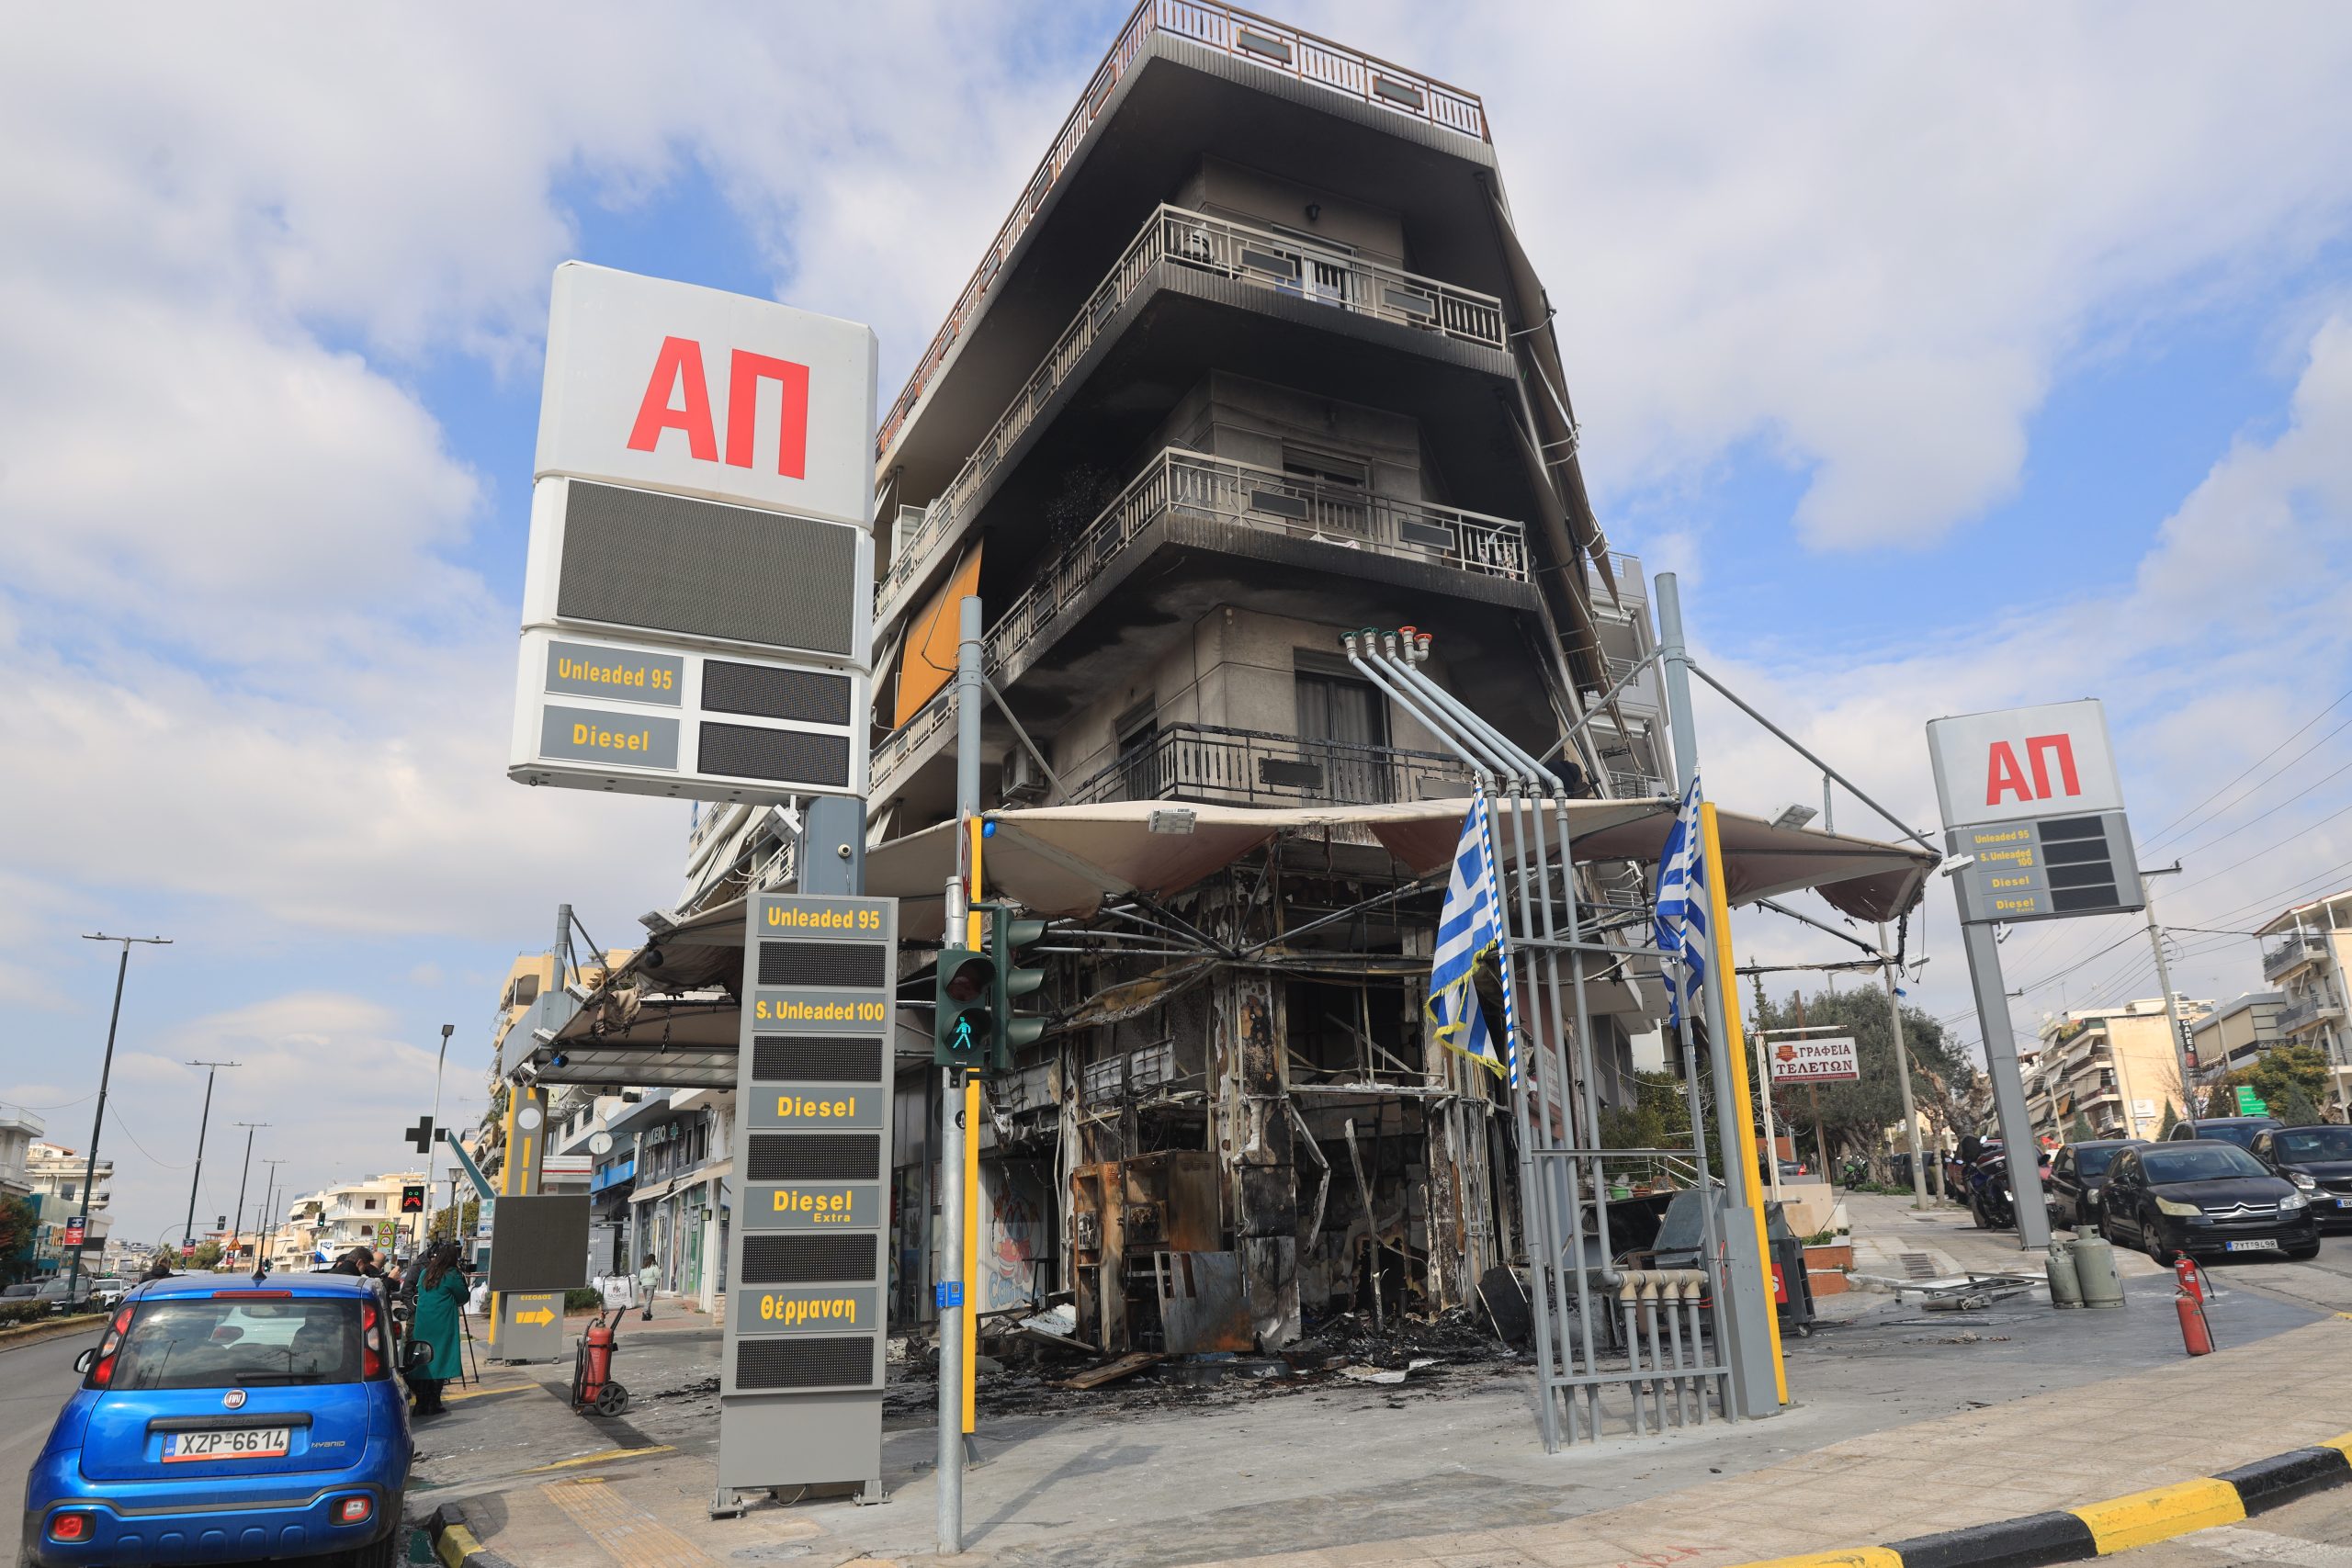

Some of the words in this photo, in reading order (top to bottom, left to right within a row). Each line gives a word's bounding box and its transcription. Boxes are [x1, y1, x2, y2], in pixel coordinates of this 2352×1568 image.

[559, 659, 645, 687] Unleaded
[651, 668, 673, 690] 95
[573, 724, 650, 751] Diesel
[1974, 831, 2017, 843] Unleaded
[2018, 829, 2030, 839] 95
[1980, 852, 1989, 862] S.
[1990, 848, 2031, 861] Unleaded
[2018, 857, 2033, 866] 100
[1992, 875, 2030, 887] Diesel
[1996, 897, 2034, 909] Diesel
[767, 907, 854, 930] Unleaded
[858, 910, 880, 930] 95
[755, 1000, 773, 1020] S.
[775, 1000, 855, 1021] Unleaded
[857, 1002, 885, 1021] 100
[2182, 1021, 2195, 1052] GAMES
[1799, 1043, 1851, 1057] ΓΡΑΦΕΙΑ
[1776, 1060, 1853, 1074] ΤΕΛΕΤΩΝ
[776, 1096, 855, 1118] Diesel
[773, 1190, 853, 1212] Diesel
[813, 1212, 851, 1224] Extra
[760, 1294, 856, 1325] Θέρμανση
[228, 1393, 243, 1404] FIAT
[311, 1440, 345, 1449] HYBRID
